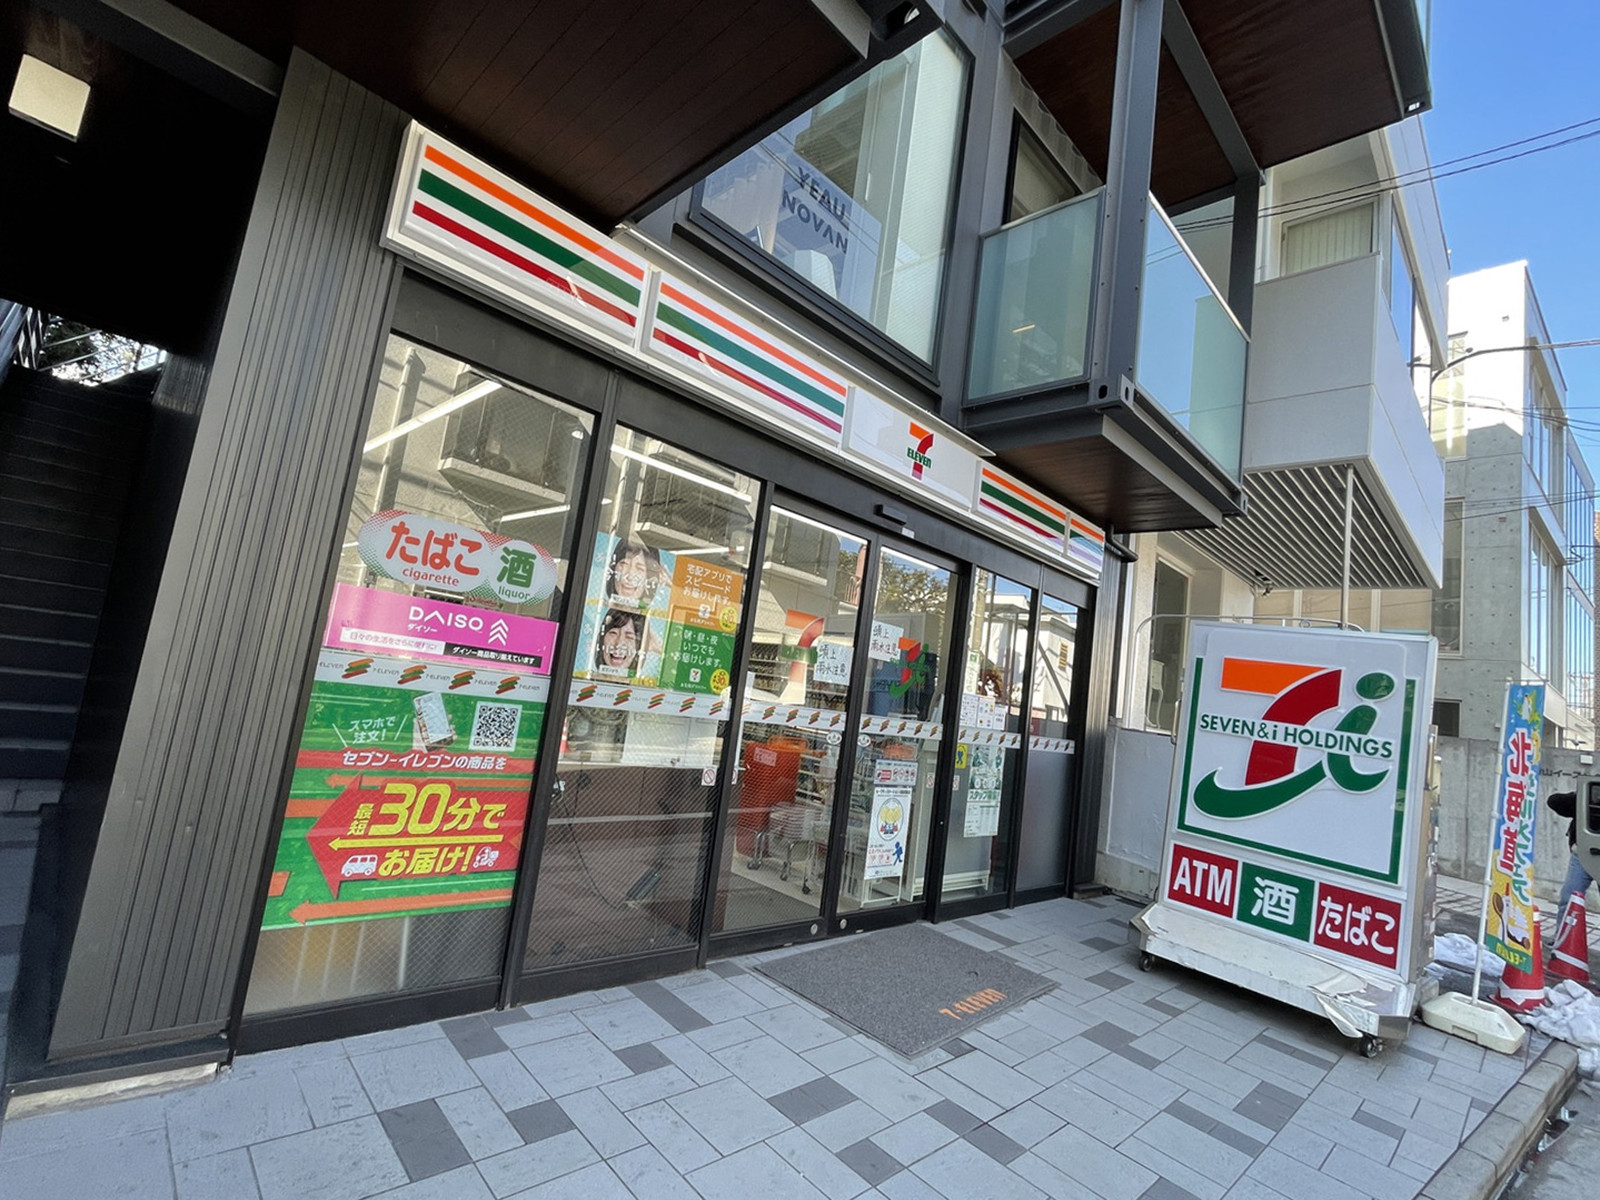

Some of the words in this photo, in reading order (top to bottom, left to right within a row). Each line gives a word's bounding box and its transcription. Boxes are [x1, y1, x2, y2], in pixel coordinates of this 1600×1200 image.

[385, 521, 483, 576] たばこ
[496, 546, 537, 589] 酒
[402, 567, 460, 587] cigarette
[499, 585, 531, 601] liquor
[687, 563, 732, 584] 宅配アプリで
[407, 623, 438, 633] ダイソー
[408, 606, 484, 631] DAISO
[683, 642, 715, 656] いつでも
[348, 716, 396, 732] スマホで
[1283, 729, 1393, 758] HOLDINGS
[378, 847, 474, 877] お届け!
[1173, 857, 1233, 906] ATM
[1251, 876, 1299, 926] 酒
[1317, 896, 1397, 955] たばこ
